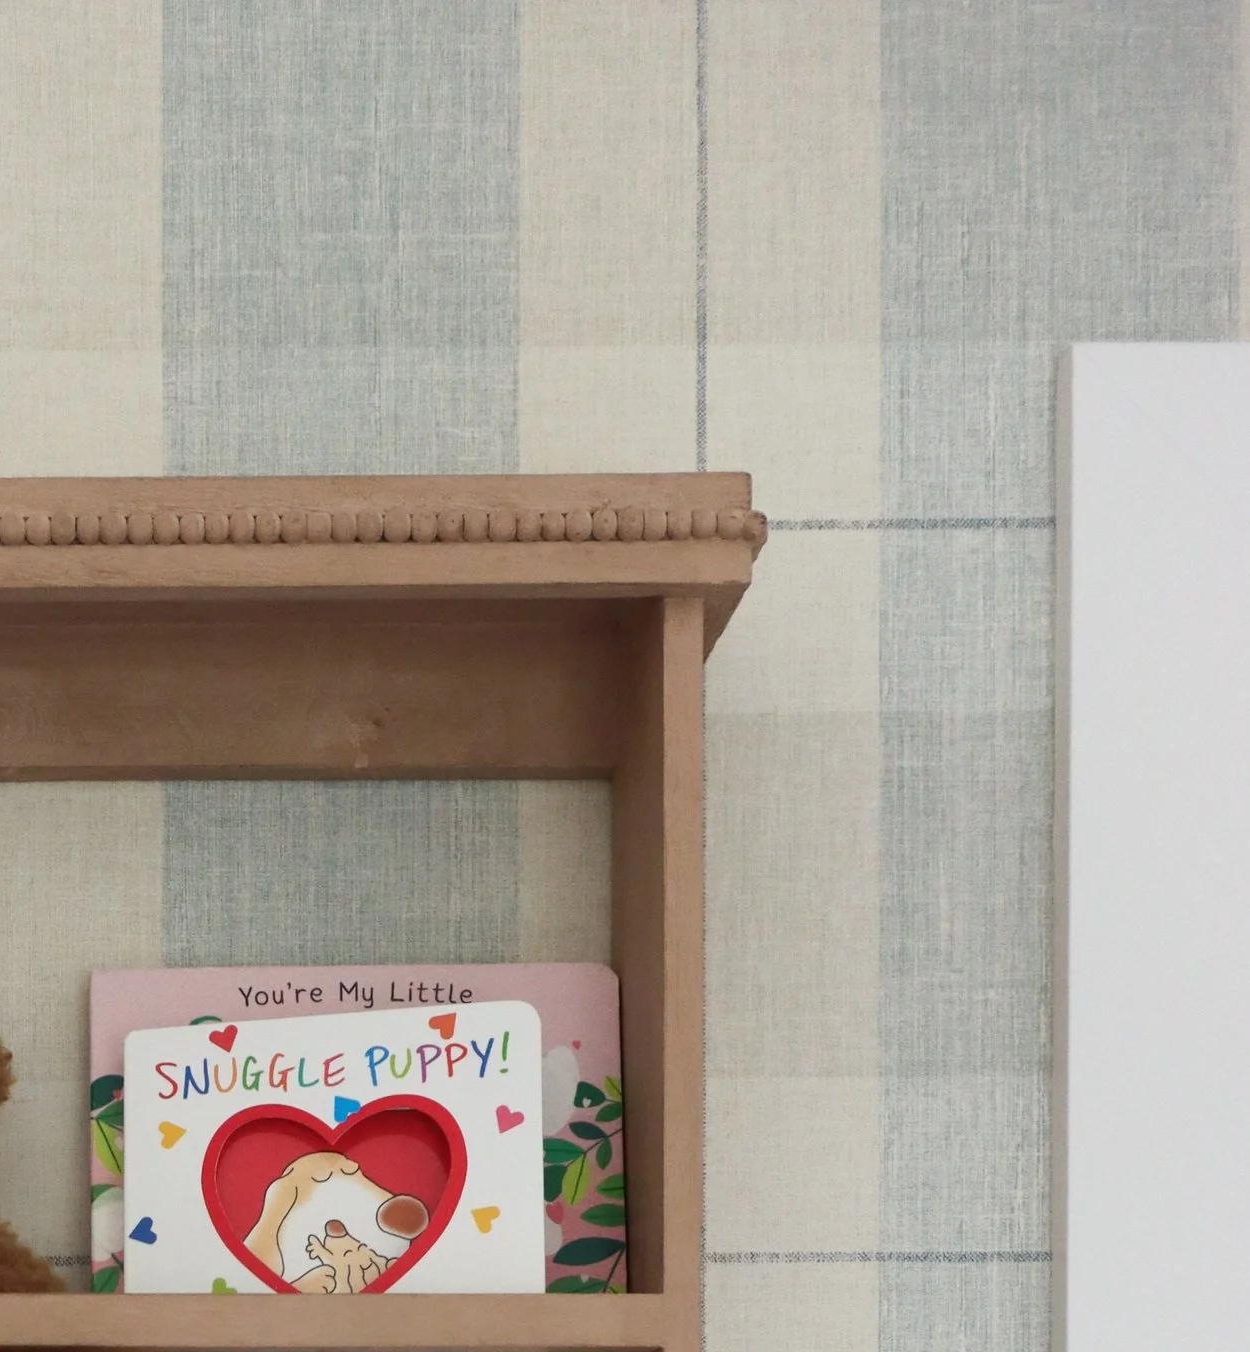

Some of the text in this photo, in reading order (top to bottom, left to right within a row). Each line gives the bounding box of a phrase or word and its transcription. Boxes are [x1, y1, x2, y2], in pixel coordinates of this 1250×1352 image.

[238, 981, 473, 1009] You're My Little
[154, 1031, 510, 1100] SNUGGLE PUPPY!
